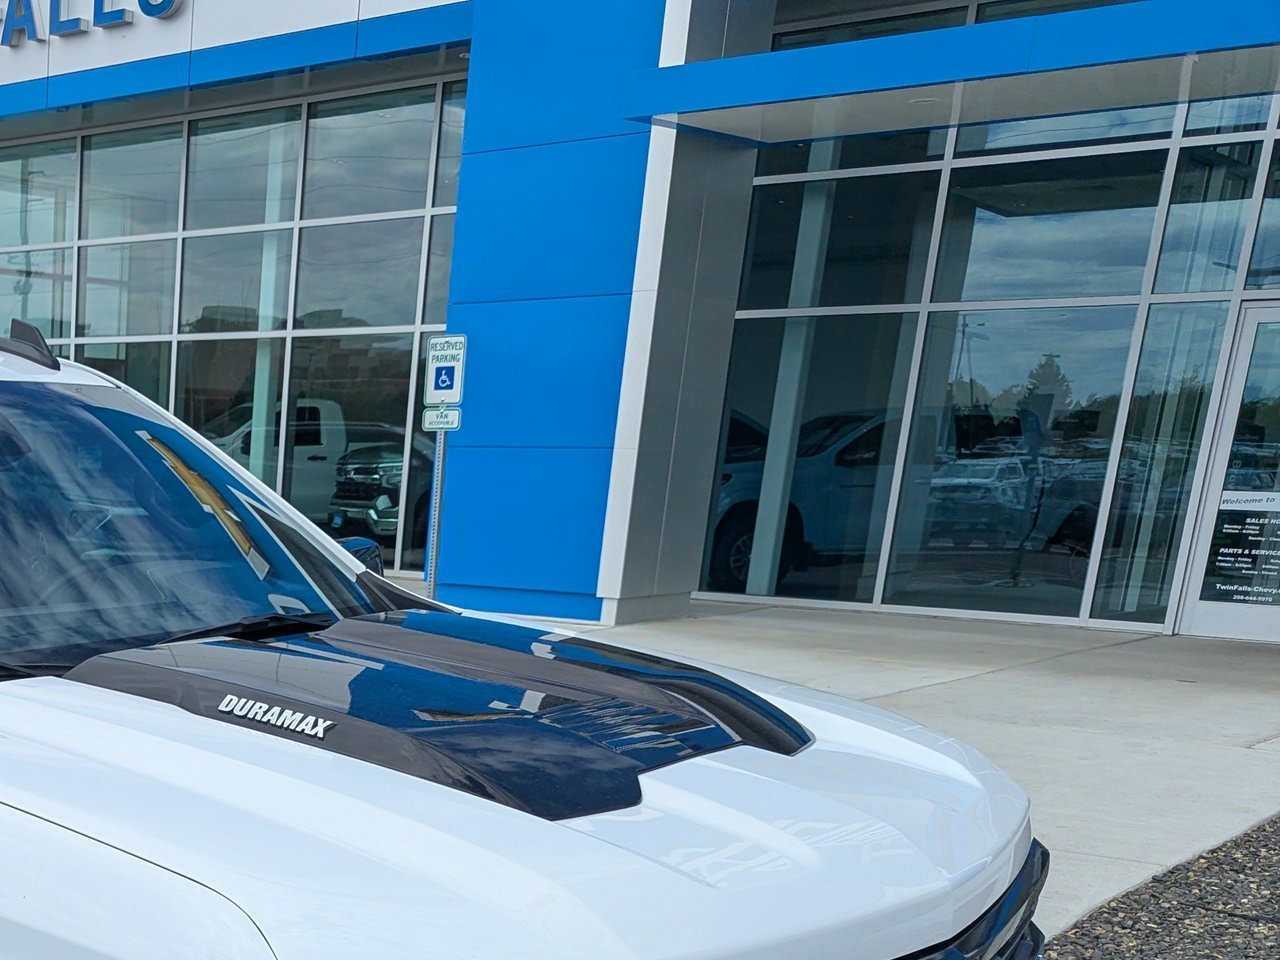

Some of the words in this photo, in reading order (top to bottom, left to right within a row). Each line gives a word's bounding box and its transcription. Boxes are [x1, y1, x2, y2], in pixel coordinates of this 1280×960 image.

[431, 342, 463, 351] RESERVED
[431, 354, 460, 363] PARKING
[217, 693, 336, 740] DURAMAX
